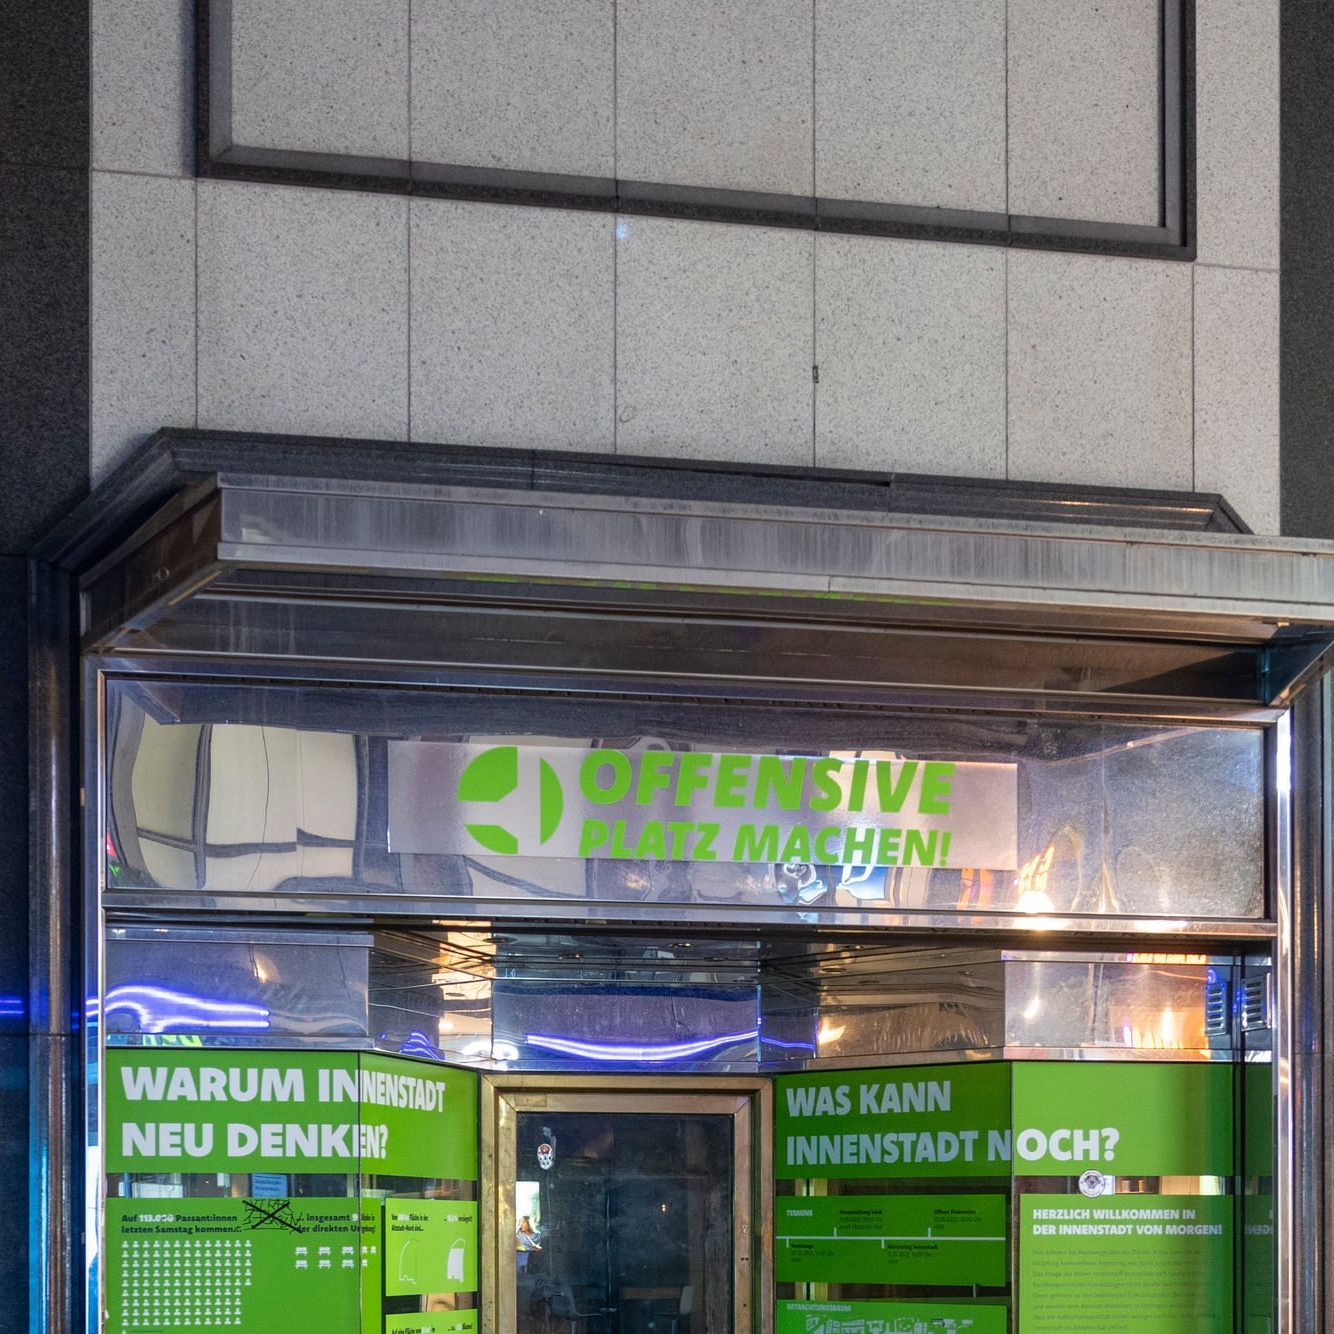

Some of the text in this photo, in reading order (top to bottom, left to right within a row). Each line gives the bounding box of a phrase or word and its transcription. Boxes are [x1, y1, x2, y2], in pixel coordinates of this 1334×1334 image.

[580, 749, 957, 816] OFFENSIVE
[579, 819, 953, 870] PLATZ MACHEN!
[121, 1066, 446, 1113] WARUM INNENSTADT
[786, 1080, 952, 1118] WAS KANN
[122, 1123, 388, 1159] NEU DENKEN?
[786, 1126, 1120, 1166] INNENSTADT NOCH?
[122, 1214, 138, 1222] Auf
[787, 1209, 813, 1217] TERMINE
[1033, 1209, 1196, 1219] HERZLICH WILLKOMMEN IN
[307, 1214, 350, 1223] insgesamt
[122, 1225, 154, 1233] letzten
[155, 1225, 193, 1235] Samstag
[313, 1225, 348, 1233] direkten
[1033, 1225, 1223, 1235] DER INNENSTADT VON MORGEN!
